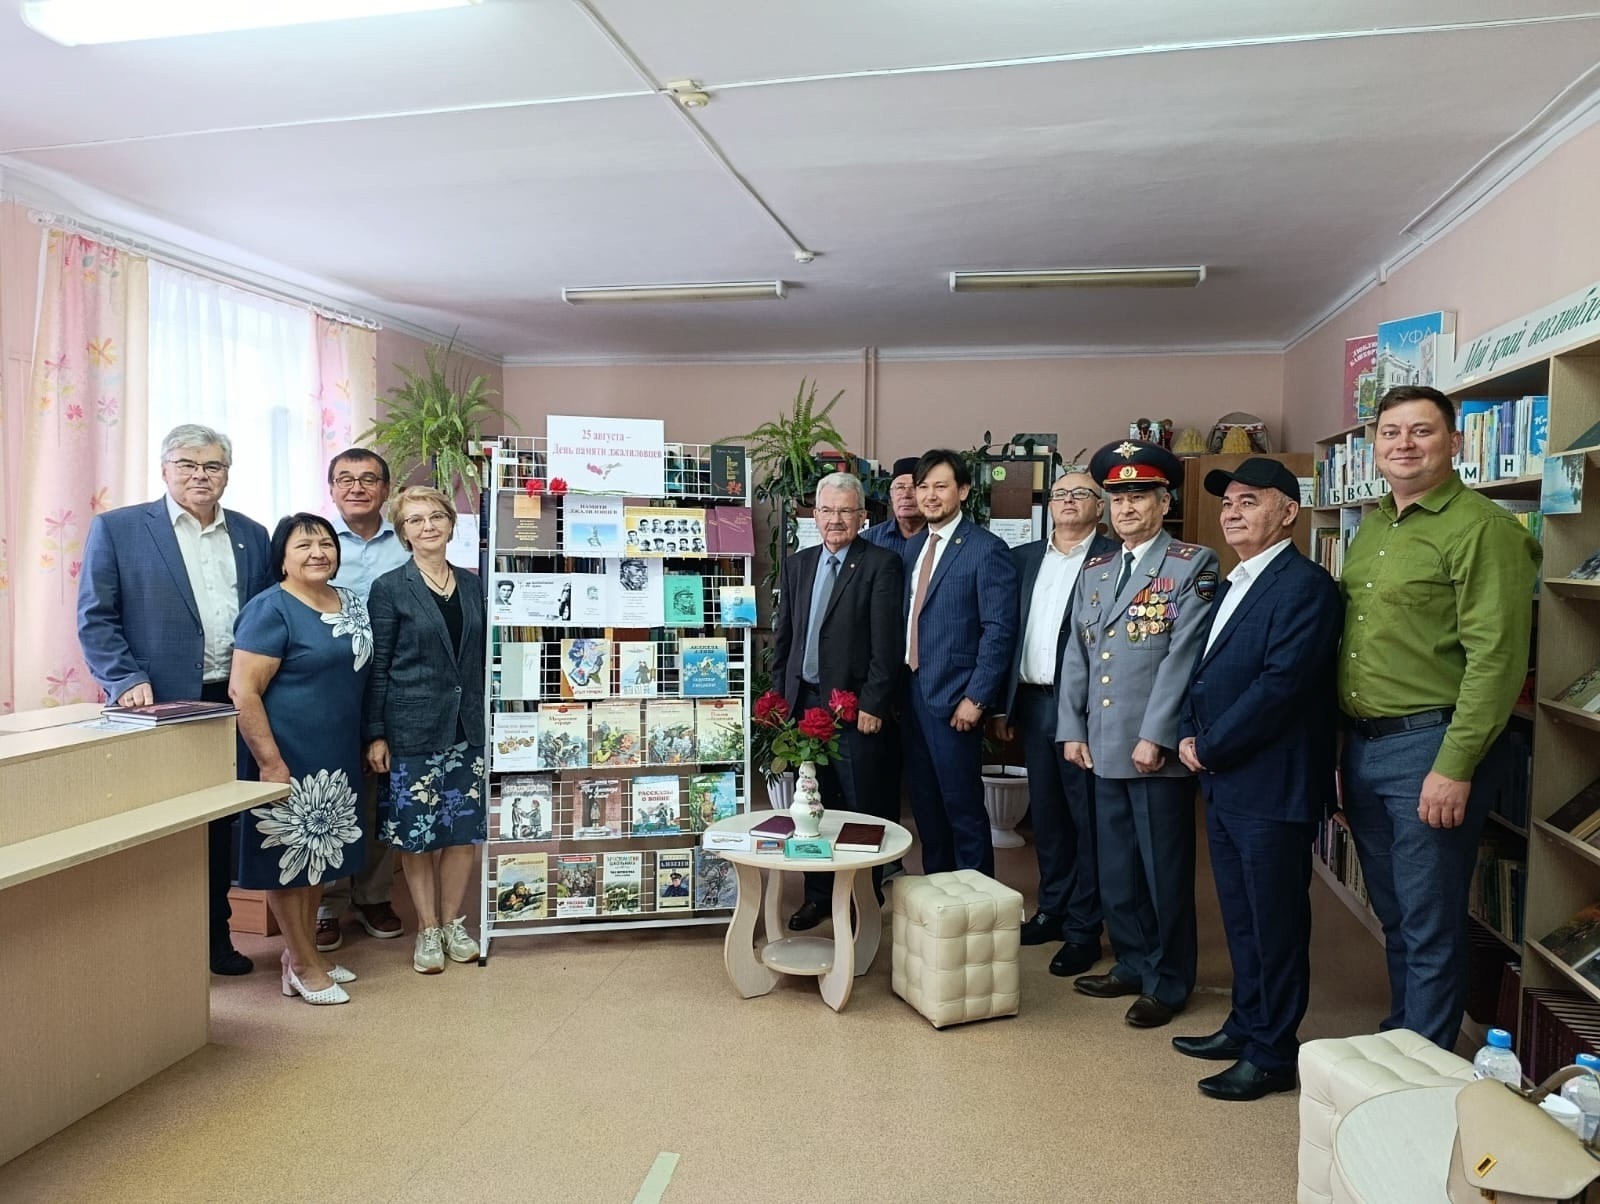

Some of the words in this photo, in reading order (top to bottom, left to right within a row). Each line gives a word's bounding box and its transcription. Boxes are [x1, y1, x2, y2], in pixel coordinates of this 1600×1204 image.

[582, 429, 591, 440] 25
[593, 433, 625, 443] августа
[552, 444, 574, 455] День
[576, 448, 607, 456] памяти
[608, 449, 662, 458] джалиловцев
[1504, 458, 1514, 472] Н
[1464, 466, 1477, 479] М
[1333, 490, 1340, 503] Б
[1347, 487, 1355, 501] В
[1364, 483, 1373, 497] Х
[1305, 493, 1313, 505] А
